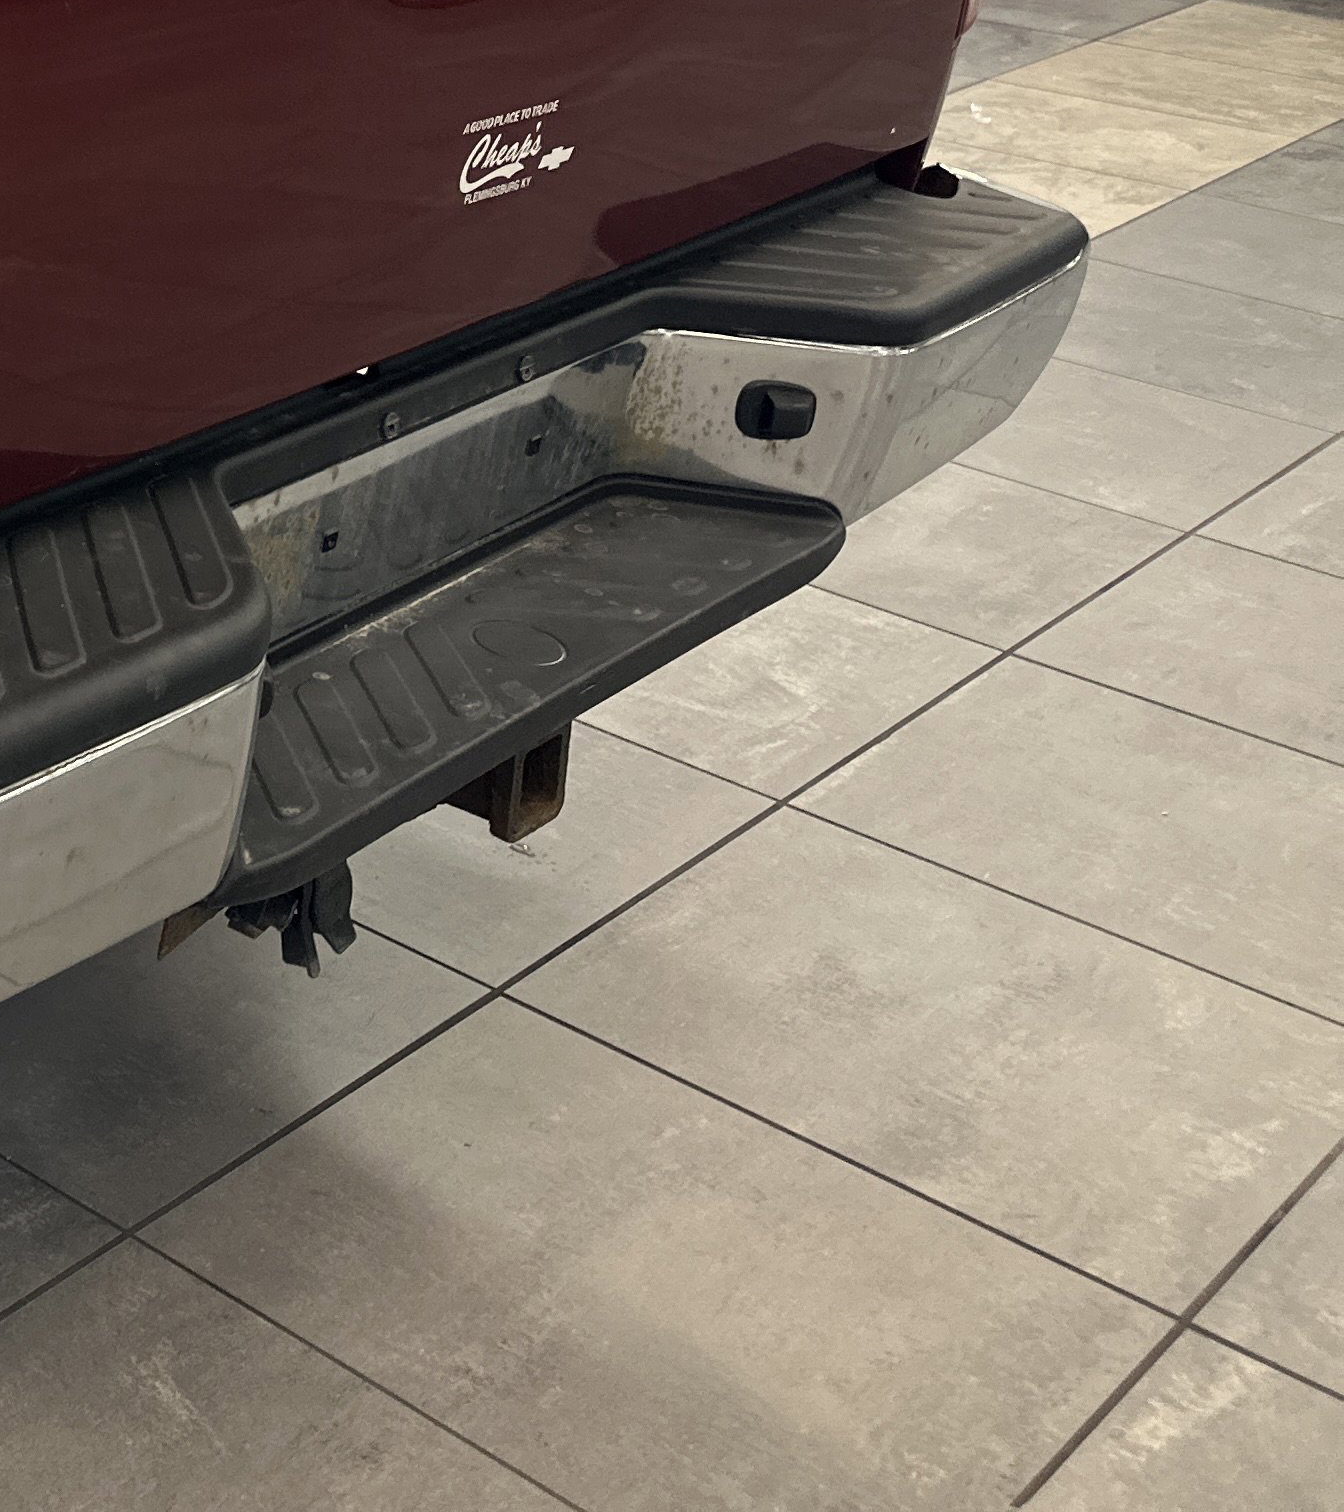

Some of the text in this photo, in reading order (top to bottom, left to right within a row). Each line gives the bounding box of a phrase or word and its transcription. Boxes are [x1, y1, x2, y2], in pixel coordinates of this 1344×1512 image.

[470, 117, 494, 133] GOOD
[494, 110, 520, 127] PLACE
[520, 107, 532, 120] TO
[532, 100, 559, 117] TRADE
